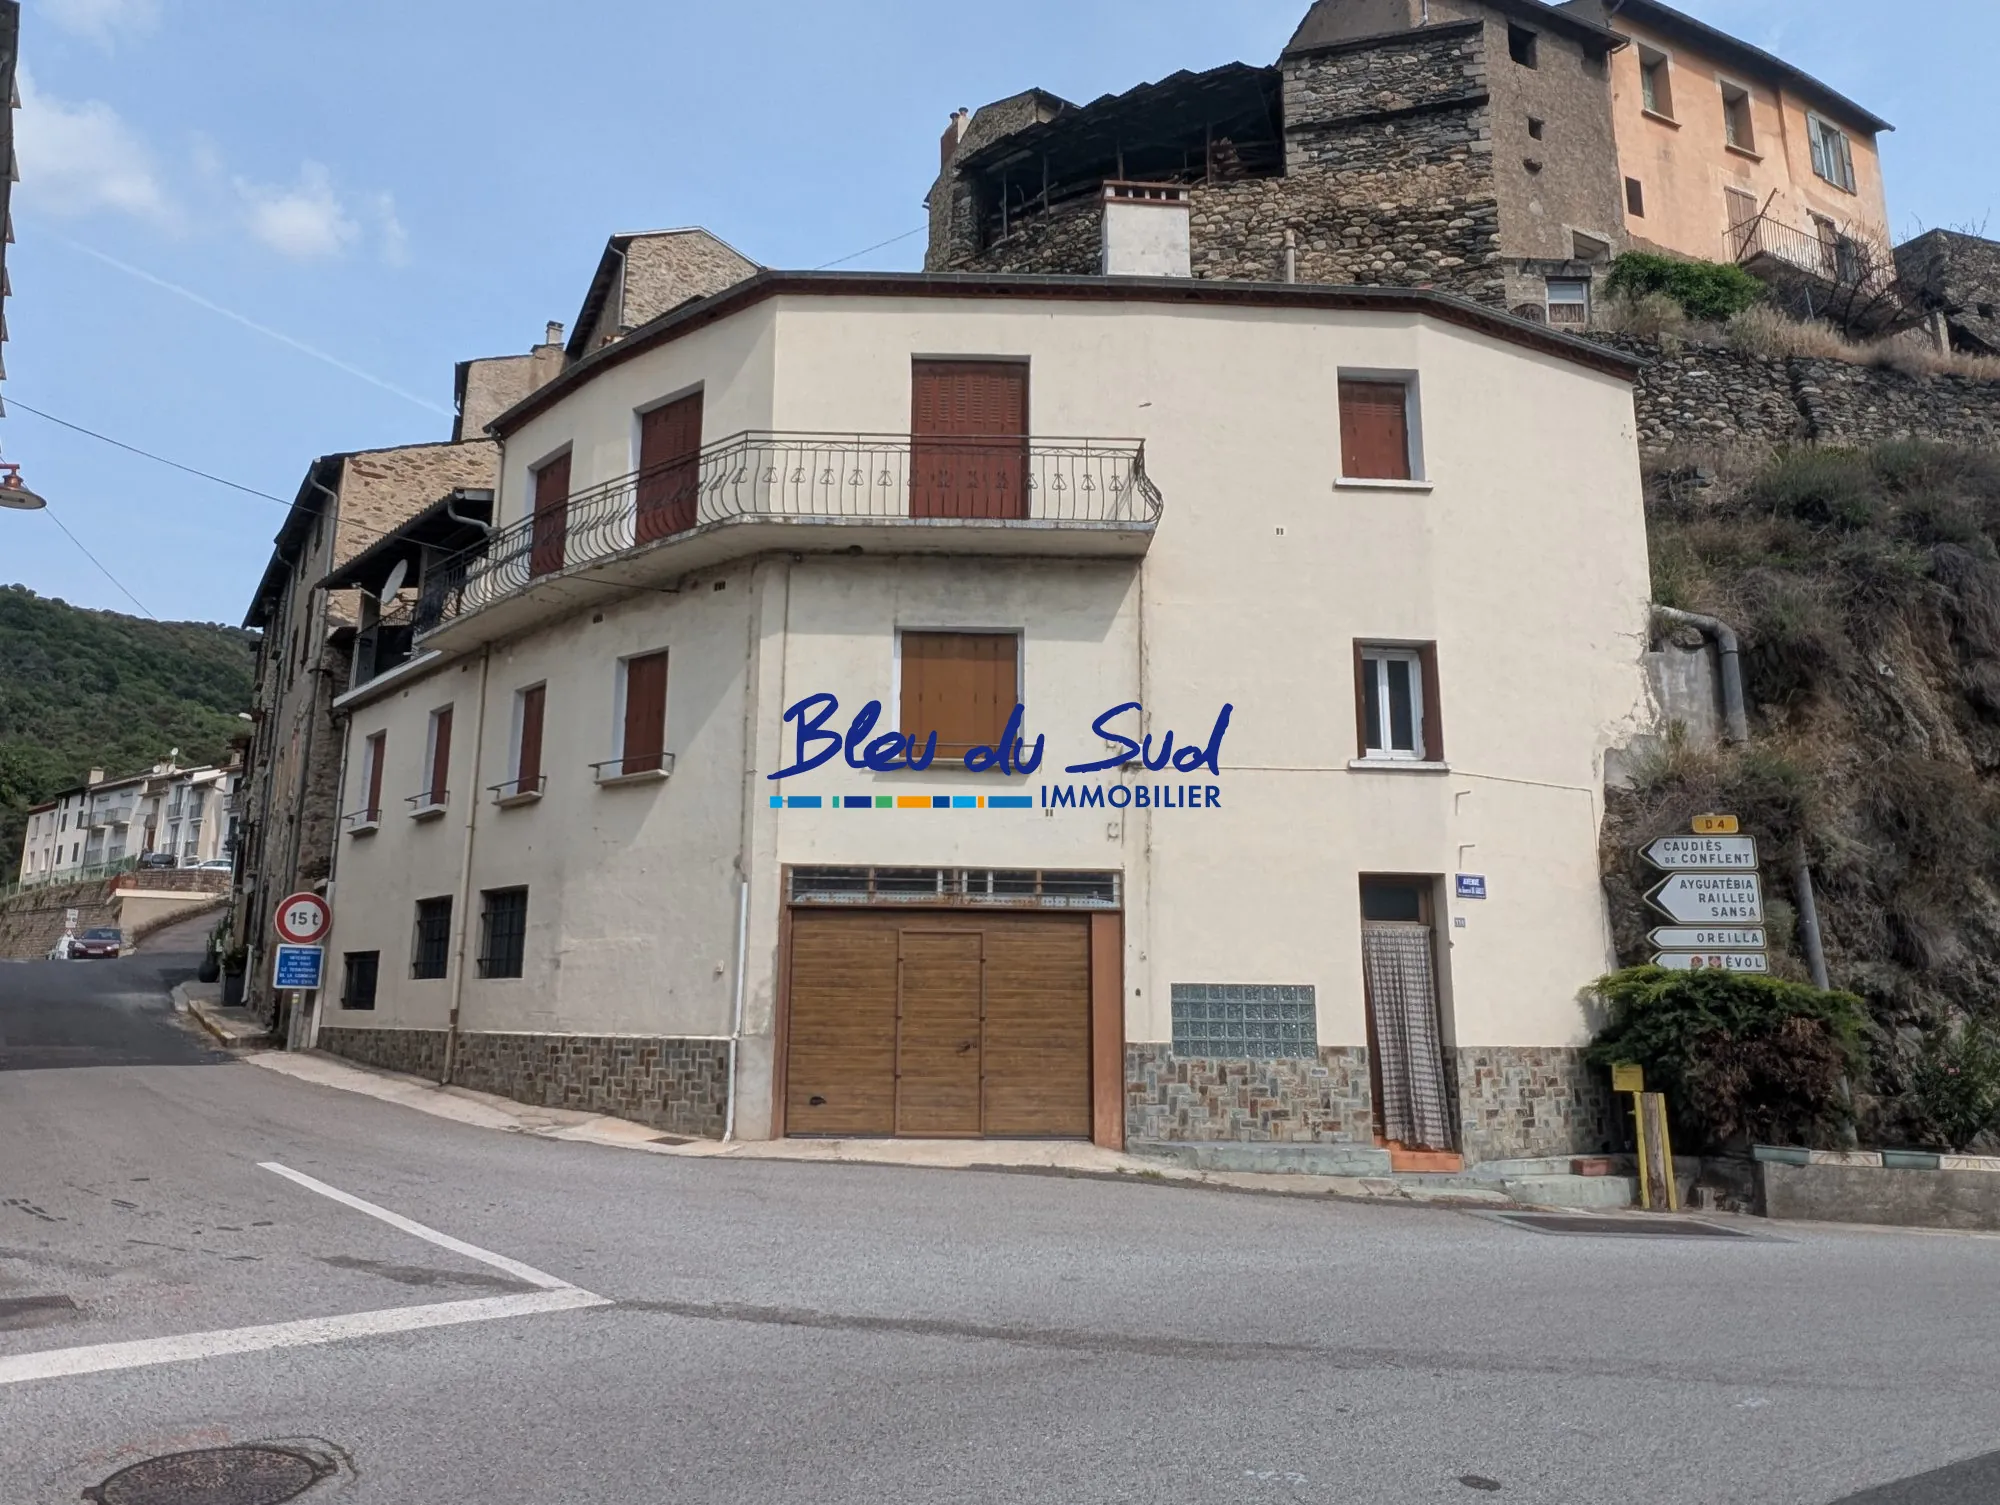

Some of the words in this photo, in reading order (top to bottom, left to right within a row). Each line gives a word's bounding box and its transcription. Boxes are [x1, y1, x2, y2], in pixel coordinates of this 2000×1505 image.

[1705, 820, 1712, 829] D
[1717, 820, 1725, 829] 4
[1663, 840, 1722, 851] CAUDIÈS
[1681, 854, 1750, 864] CONFLENT
[1680, 878, 1753, 889] AYGUATÉBIA
[1698, 893, 1755, 903] RAILLEU
[1711, 907, 1756, 917] SANSA
[290, 912, 308, 925] 15
[311, 912, 319, 926] t
[1696, 933, 1760, 943] OREILLA
[1725, 955, 1762, 968] ÉVOL
